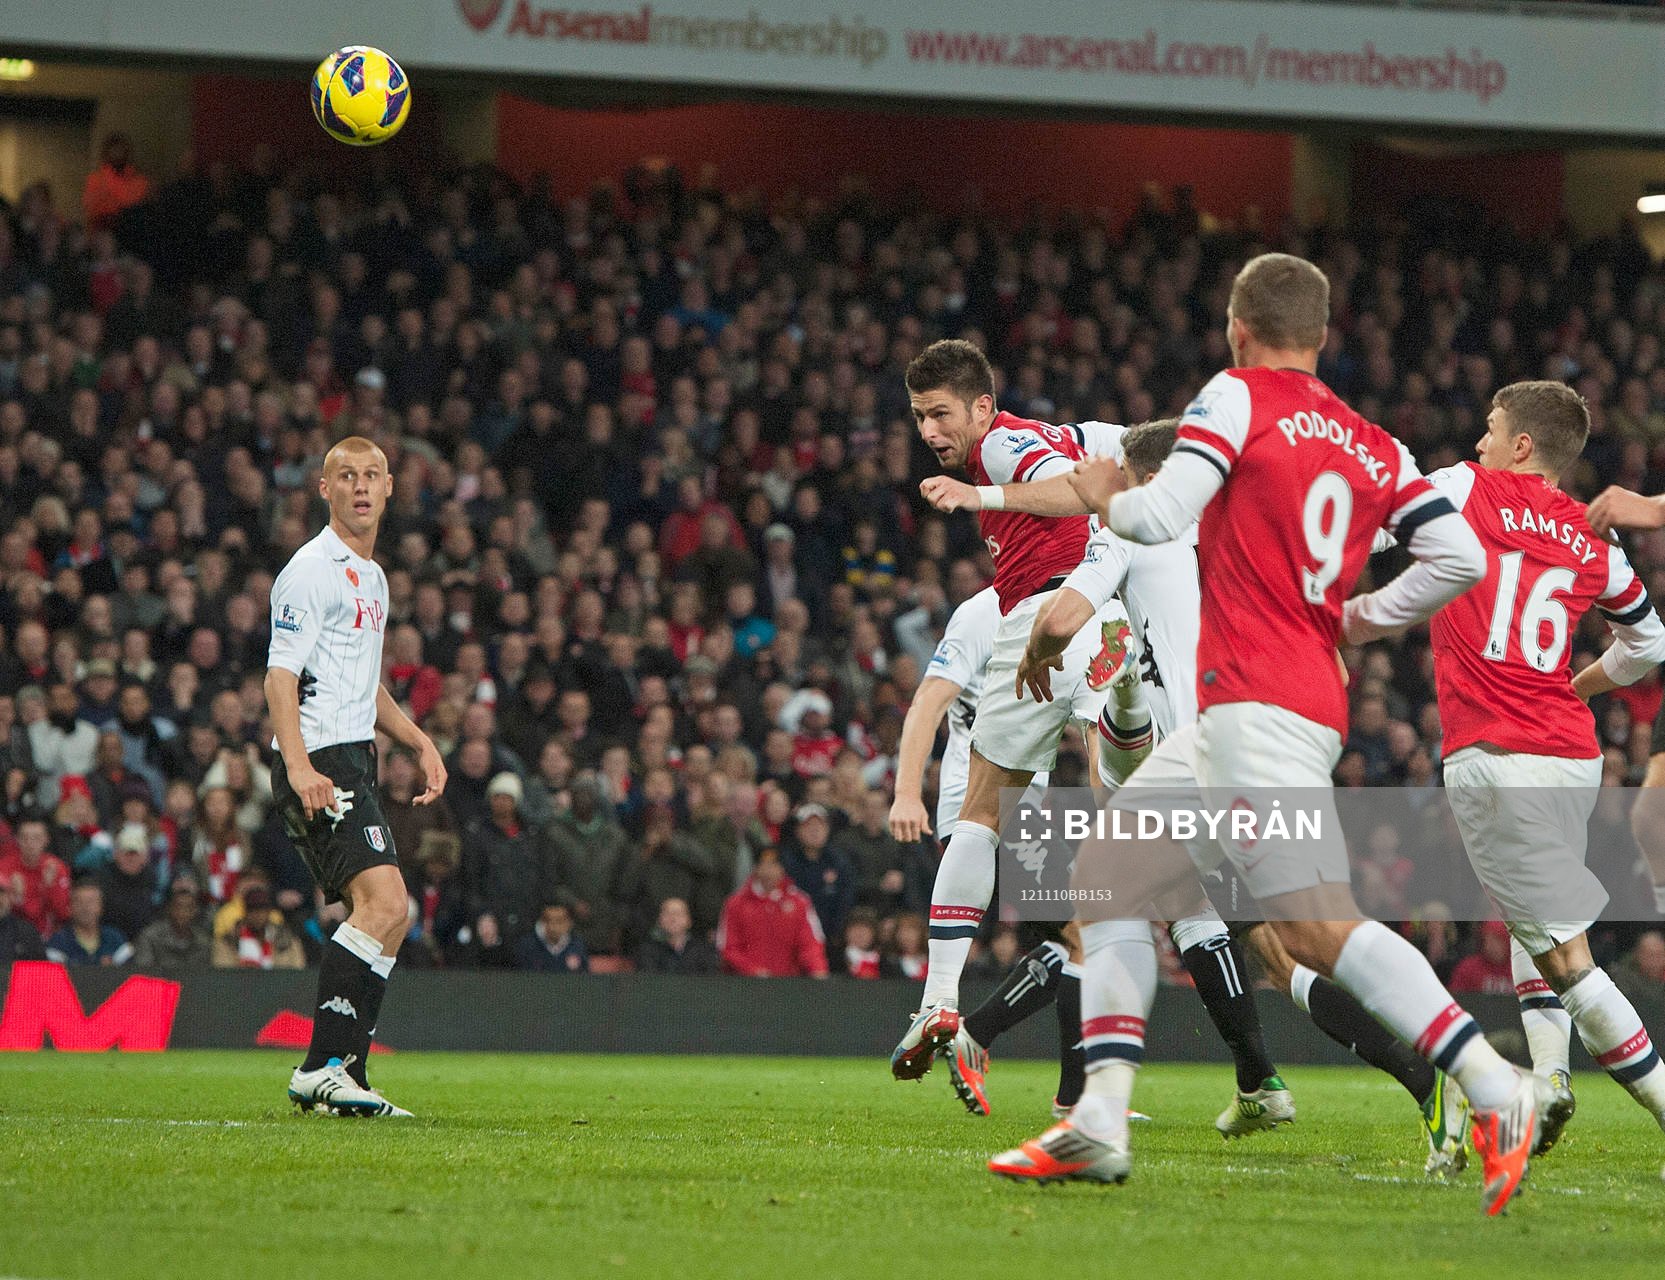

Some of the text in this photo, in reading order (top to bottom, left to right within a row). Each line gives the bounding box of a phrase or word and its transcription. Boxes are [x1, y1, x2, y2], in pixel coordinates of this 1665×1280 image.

[905, 28, 1508, 103] www.arsenal.com/membership
[1277, 410, 1391, 489] PODOLSKI
[1303, 471, 1353, 605] 9
[1500, 508, 1598, 565] RAMSEY
[1481, 550, 1578, 673] 16
